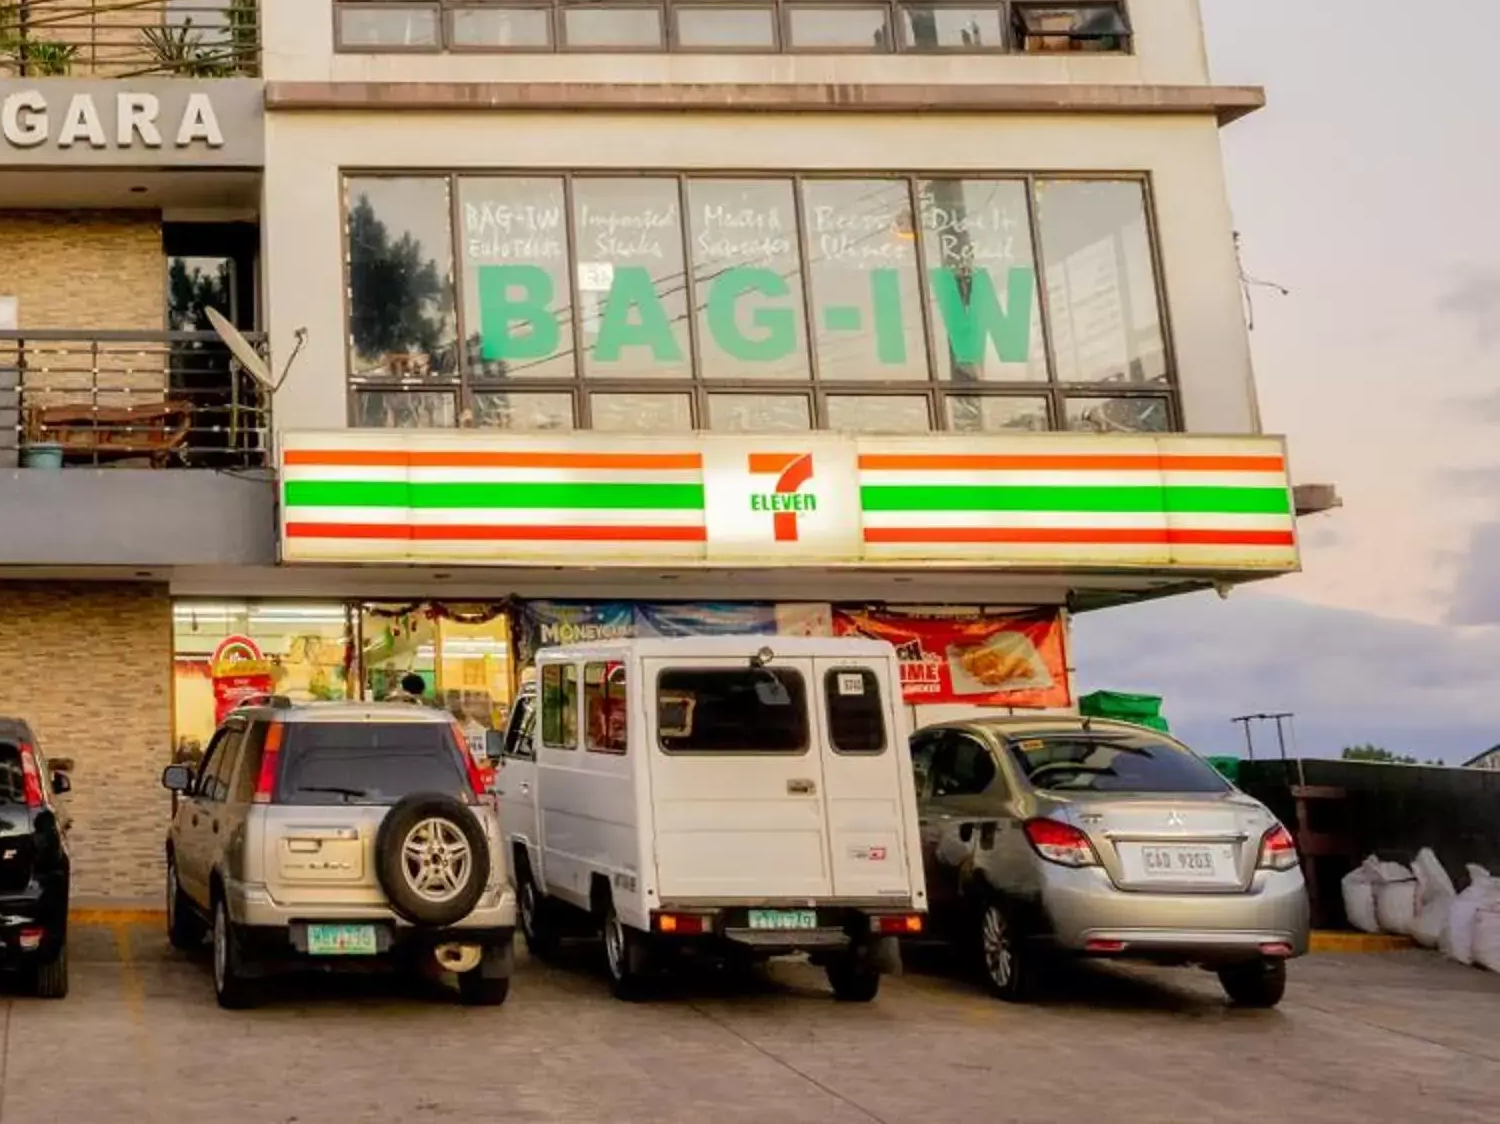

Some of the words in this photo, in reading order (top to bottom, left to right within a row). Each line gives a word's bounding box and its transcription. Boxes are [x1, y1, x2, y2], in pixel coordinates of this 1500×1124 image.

[1, 89, 225, 149] GARA
[477, 264, 1035, 364] BAG-IW
[748, 452, 814, 542] 7
